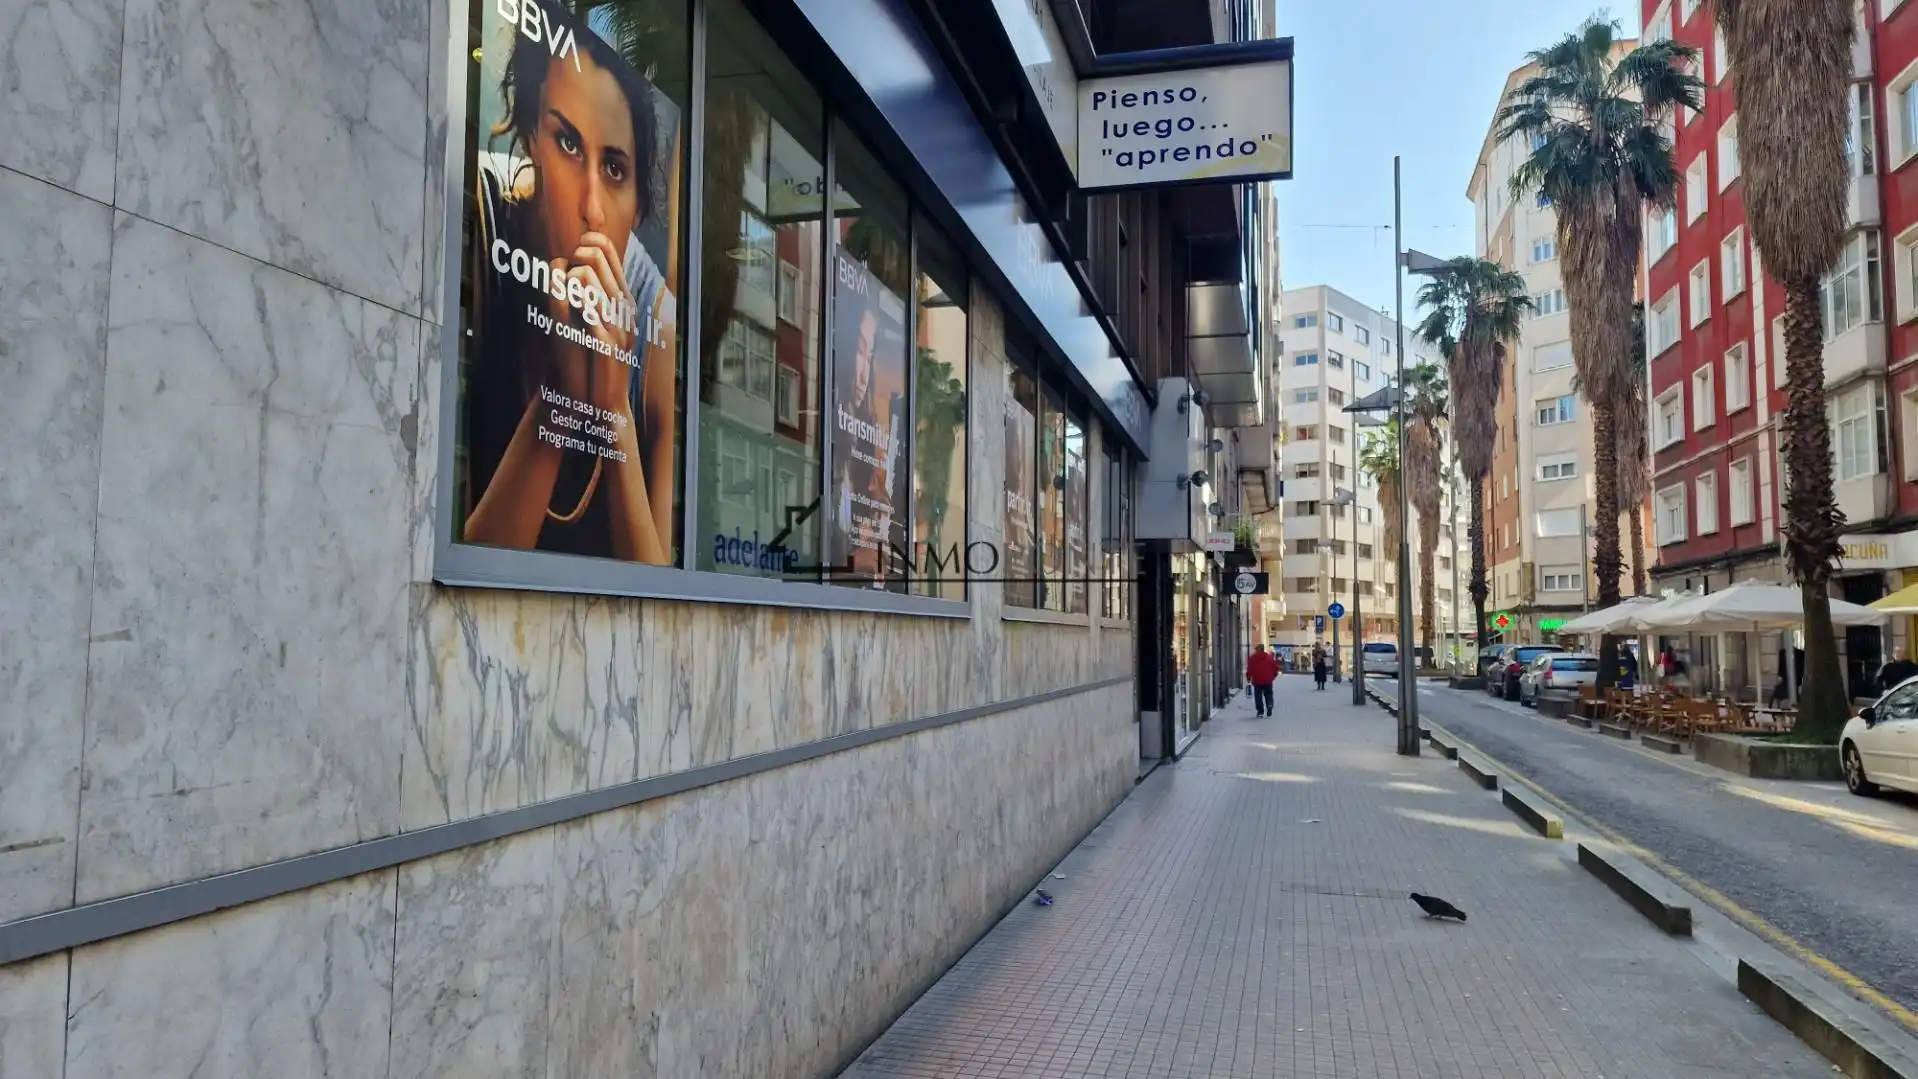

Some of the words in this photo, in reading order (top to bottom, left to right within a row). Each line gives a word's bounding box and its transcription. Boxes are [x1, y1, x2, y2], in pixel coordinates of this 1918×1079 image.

[1092, 86, 1208, 111] Pienso,
[1103, 116, 1229, 139] luego...
[1102, 133, 1273, 170] "aprendo"
[840, 256, 869, 300] BBVA
[527, 304, 553, 335] Hoy
[555, 321, 612, 357] comienza
[614, 344, 641, 369] todo.
[540, 384, 571, 409] Valora
[572, 400, 594, 416] casa
[595, 407, 601, 421] y
[602, 410, 628, 427] coche
[538, 425, 585, 452] Programa
[587, 440, 597, 454] tu
[598, 446, 627, 463] cuenta
[550, 409, 583, 431] Gestor
[584, 420, 618, 444] Contigo
